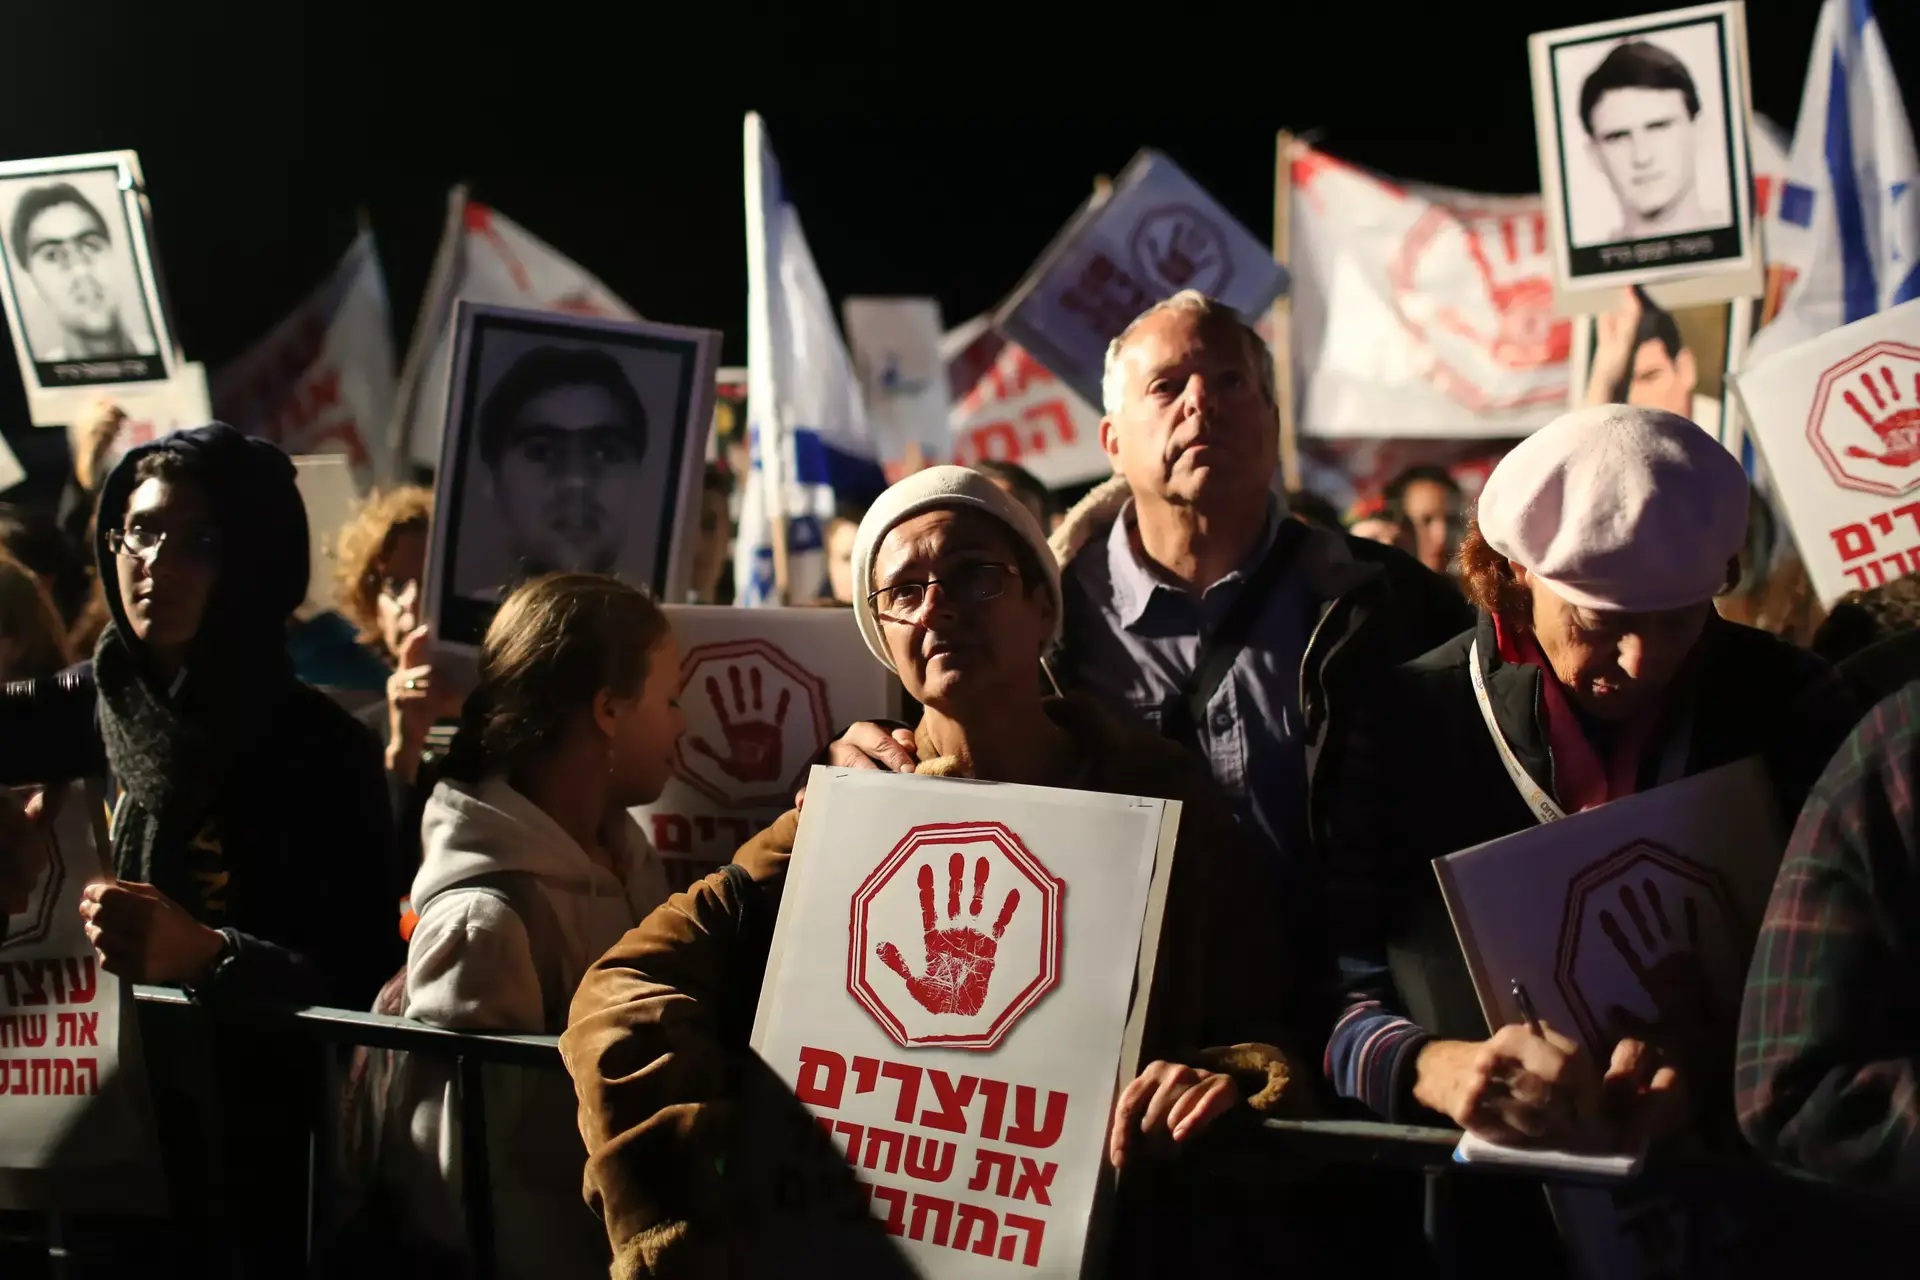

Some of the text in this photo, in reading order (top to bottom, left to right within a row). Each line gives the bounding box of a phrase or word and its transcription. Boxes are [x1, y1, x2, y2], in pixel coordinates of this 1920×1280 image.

[1830, 502, 1920, 561] רים
[56, 1012, 98, 1047] את
[795, 1046, 1069, 1149] עוצרים
[969, 1149, 1059, 1207] את
